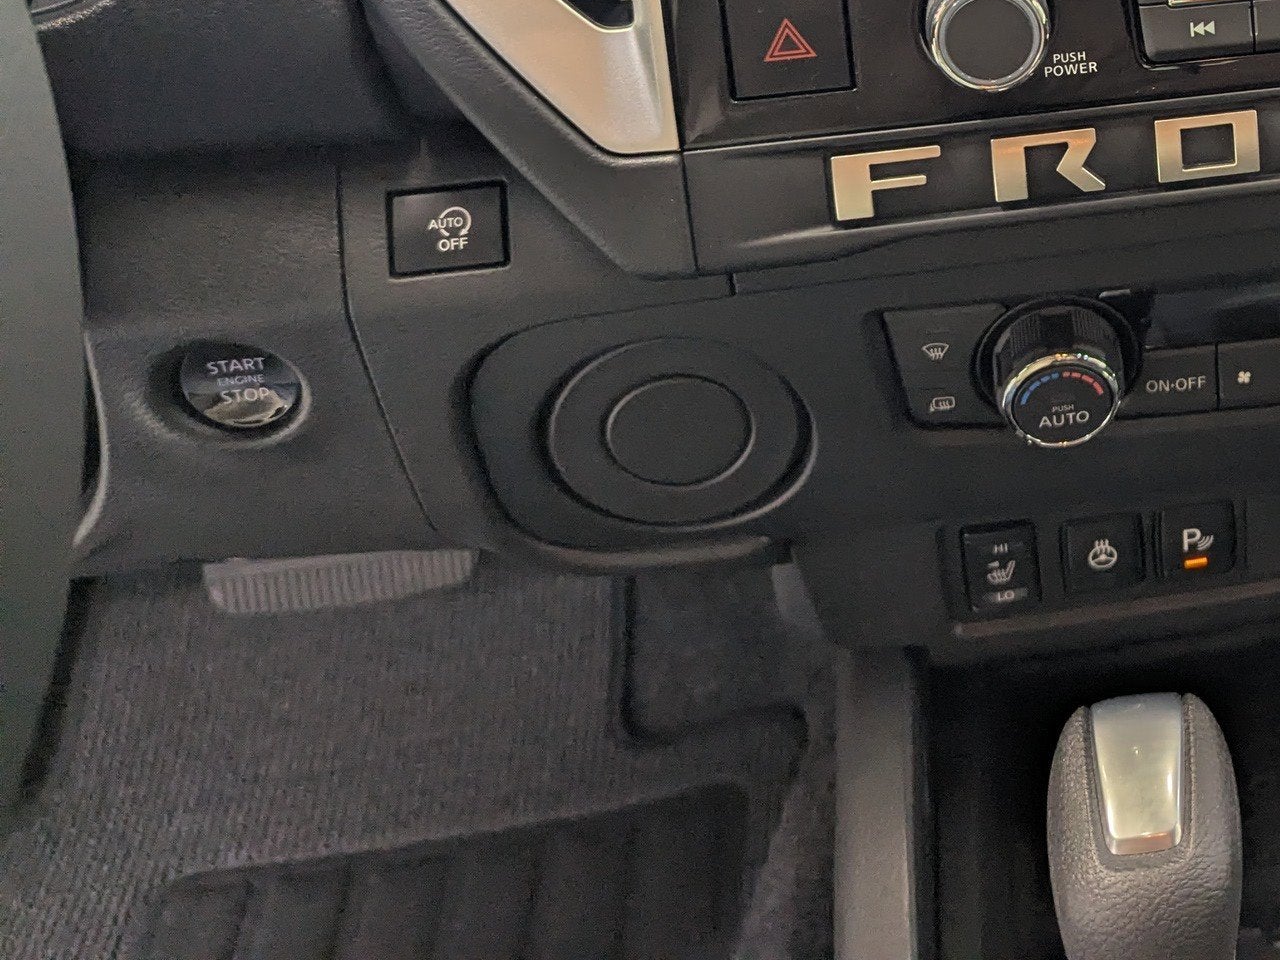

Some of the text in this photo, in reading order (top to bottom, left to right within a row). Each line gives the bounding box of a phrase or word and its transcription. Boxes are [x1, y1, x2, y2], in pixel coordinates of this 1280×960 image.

[1052, 51, 1086, 64] PUSH
[1044, 61, 1098, 78] POWER
[429, 216, 463, 230] AUTO
[437, 237, 469, 252] OFF
[206, 357, 265, 375] START
[220, 386, 270, 404] STOP
[1039, 411, 1090, 429] AUTO
